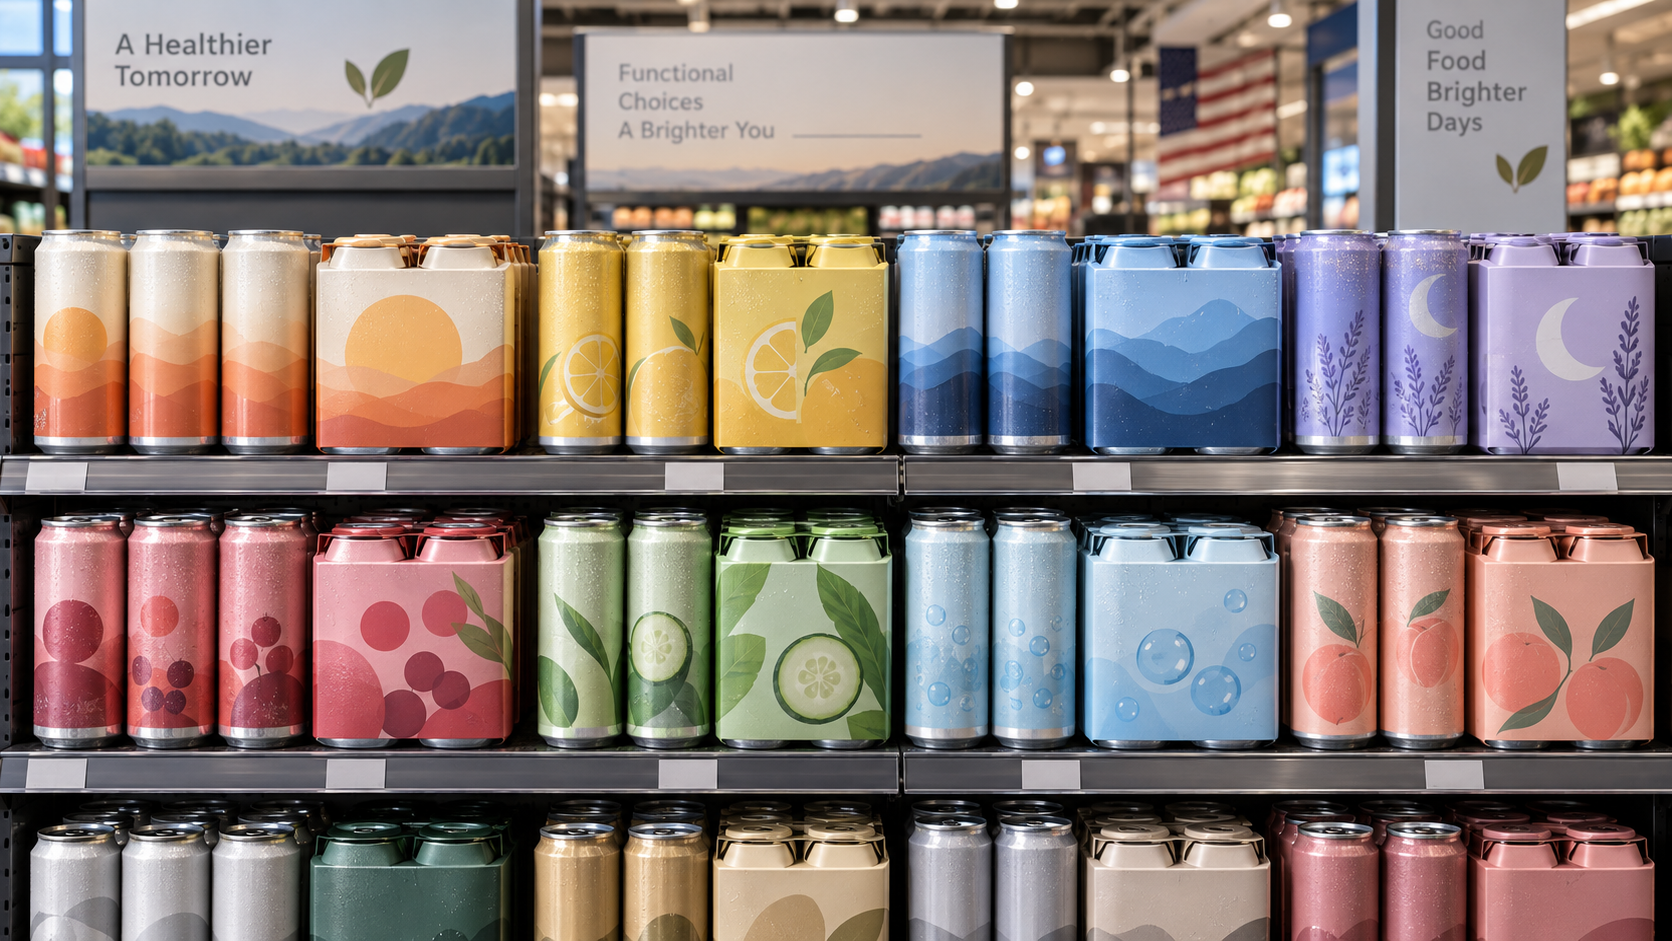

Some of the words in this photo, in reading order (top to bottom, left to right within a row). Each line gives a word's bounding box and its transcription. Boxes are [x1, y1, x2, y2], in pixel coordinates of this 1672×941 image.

[1427, 19, 1484, 40] Good
[115, 33, 135, 55] A
[145, 32, 272, 56] Healthier
[1428, 49, 1486, 71] Food
[115, 65, 253, 87] Tomorrow
[618, 63, 734, 83] Functional
[618, 91, 704, 111] Choices
[1428, 80, 1528, 106] Brighter
[618, 121, 634, 140] A
[641, 119, 729, 145] Brighter
[735, 121, 775, 140] You
[1428, 111, 1483, 138] Days
